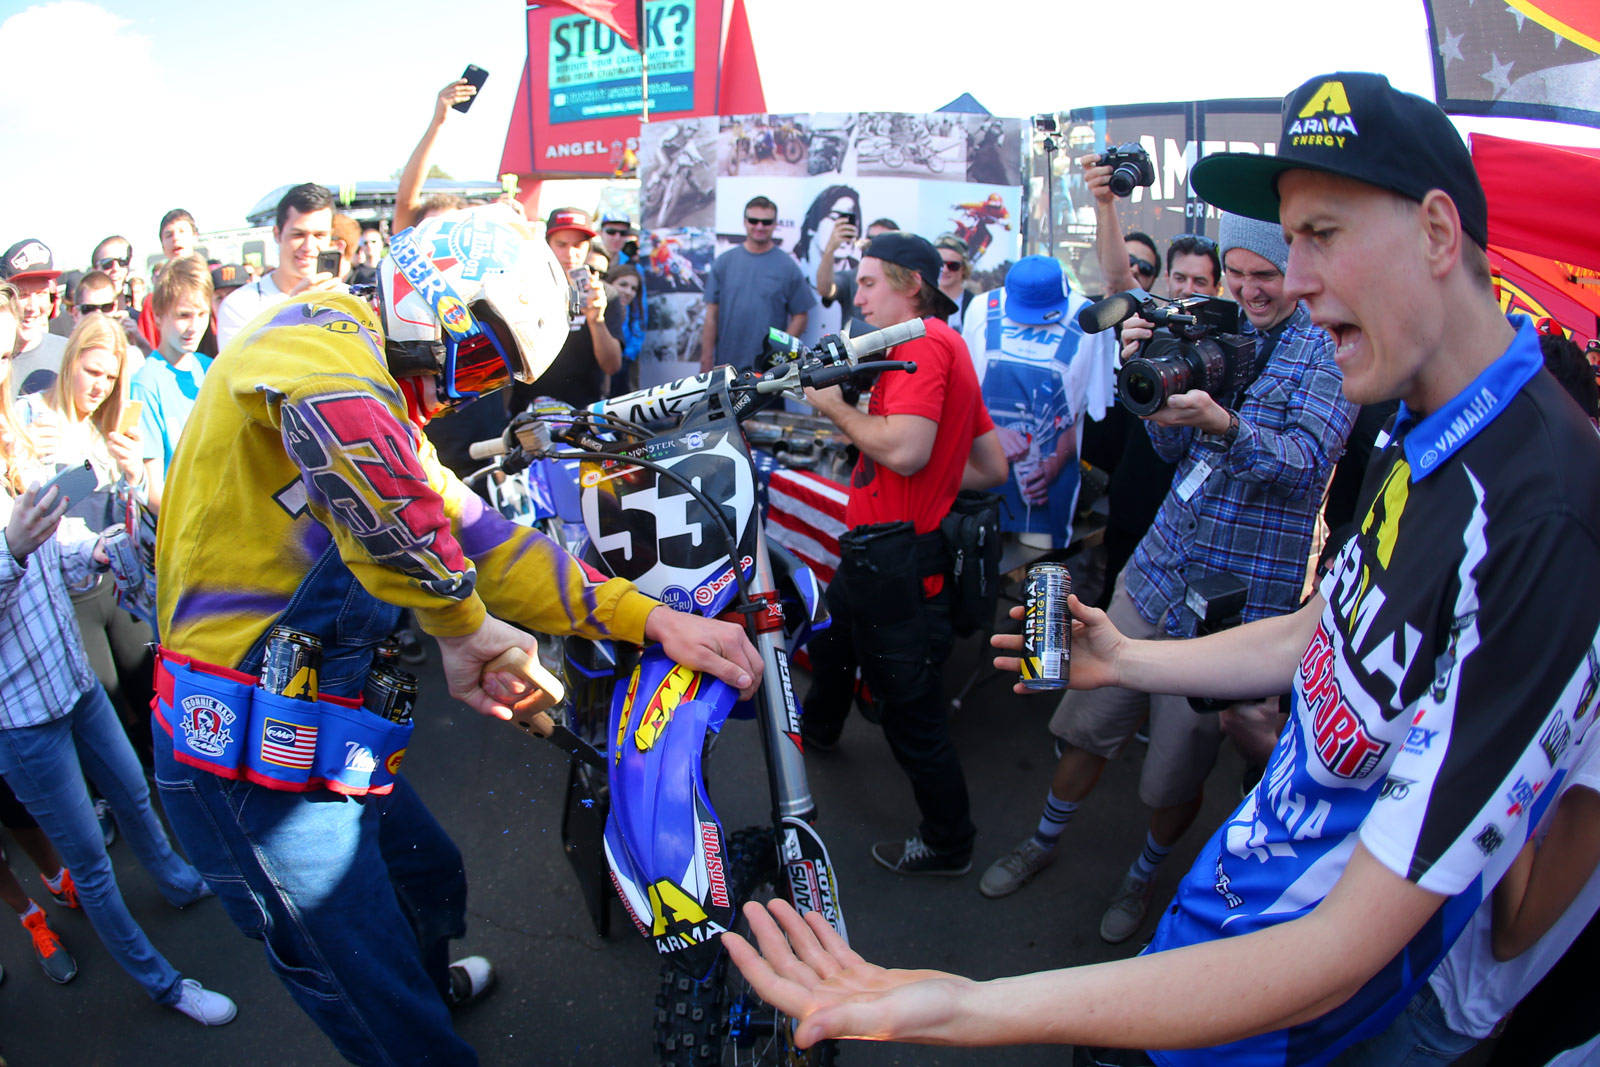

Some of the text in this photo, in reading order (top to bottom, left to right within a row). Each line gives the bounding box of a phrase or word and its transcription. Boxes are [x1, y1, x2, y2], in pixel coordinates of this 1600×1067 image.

[1288, 115, 1359, 136] ARMA
[1292, 134, 1346, 149] ENERGY
[545, 141, 608, 159] ANGEL
[388, 236, 447, 306] BEER
[1435, 386, 1498, 452] YAMAHA
[628, 440, 676, 458] MONSTER
[598, 454, 738, 581] 53
[1025, 581, 1037, 652] ARMA
[1036, 591, 1045, 642] ENERGY
[184, 697, 233, 723] RONNIE MAC
[1299, 622, 1384, 778] TOSPORT
[656, 921, 728, 954] ARMA
